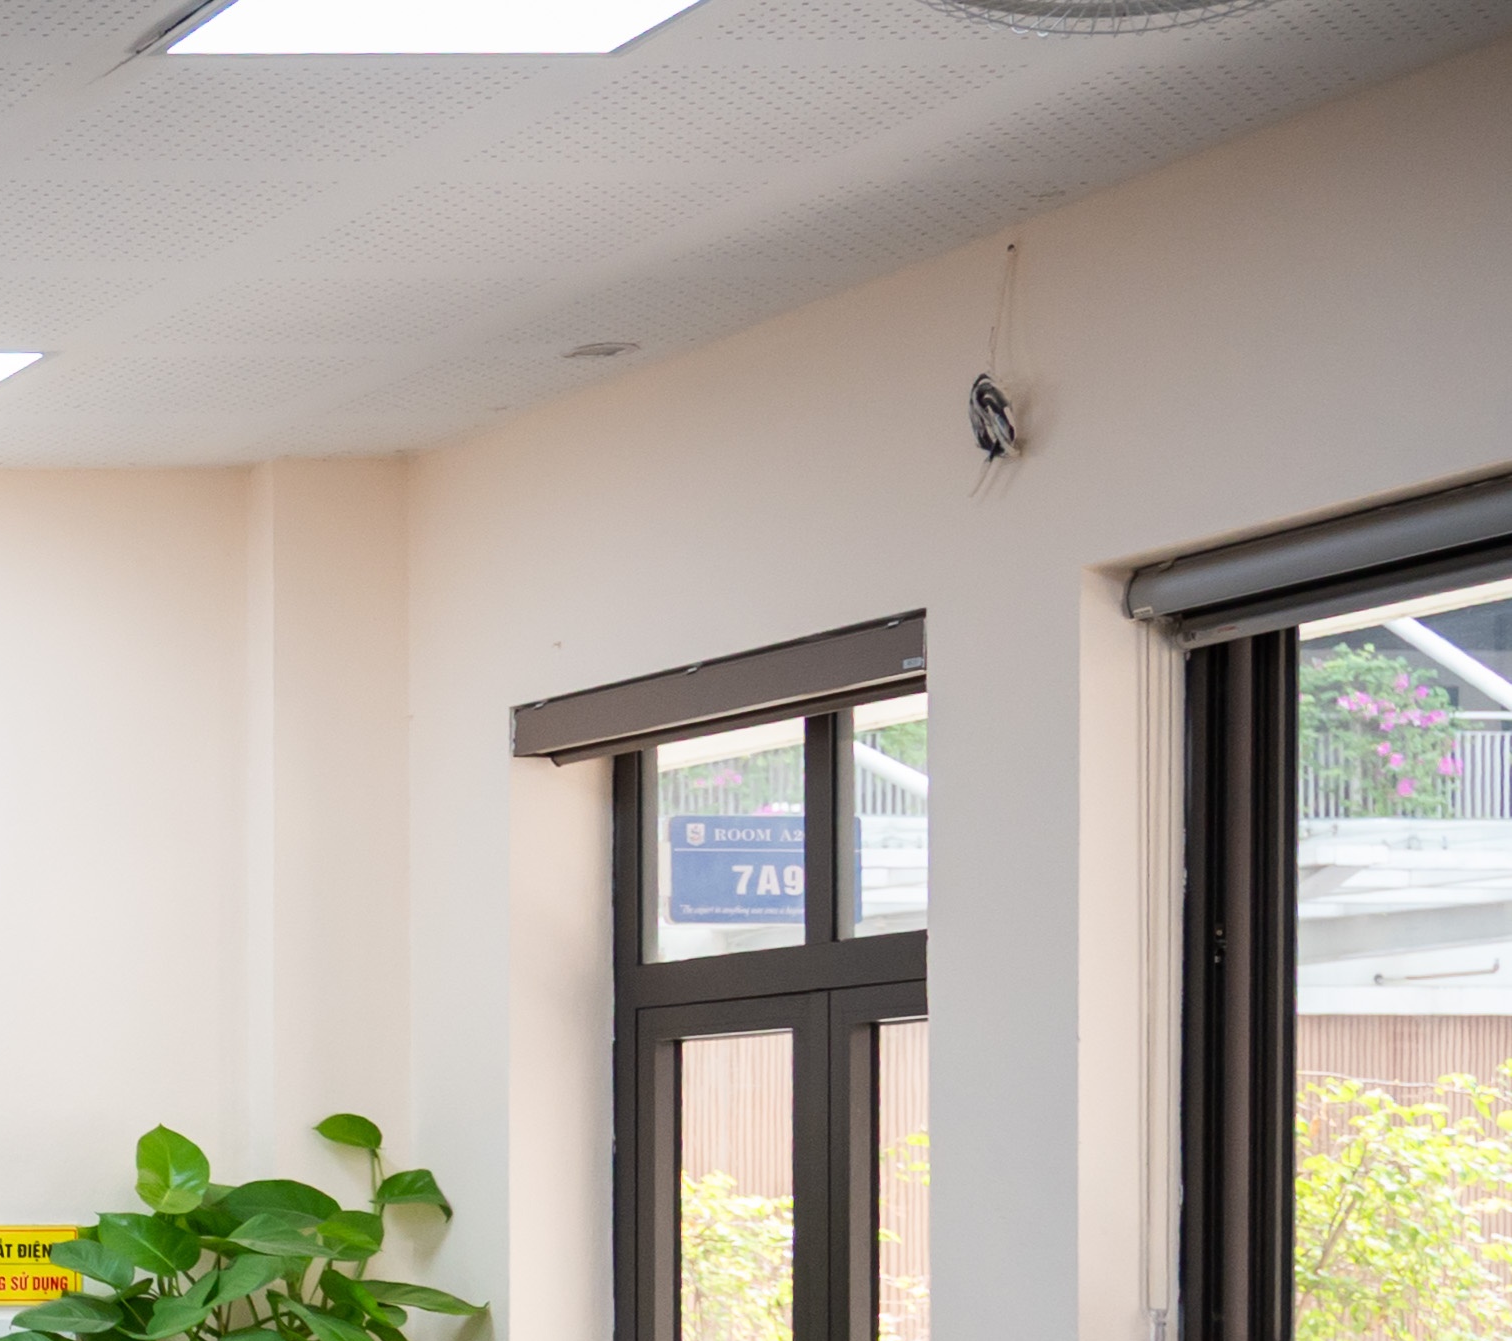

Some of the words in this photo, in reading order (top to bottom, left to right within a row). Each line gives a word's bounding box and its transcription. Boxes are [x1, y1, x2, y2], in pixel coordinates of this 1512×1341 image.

[715, 828, 771, 842] ROOM
[732, 865, 804, 896] 7A9
[17, 1241, 53, 1262] ĐIỆN
[11, 1272, 29, 1291] SỬ
[32, 1276, 68, 1294] DỤNG
